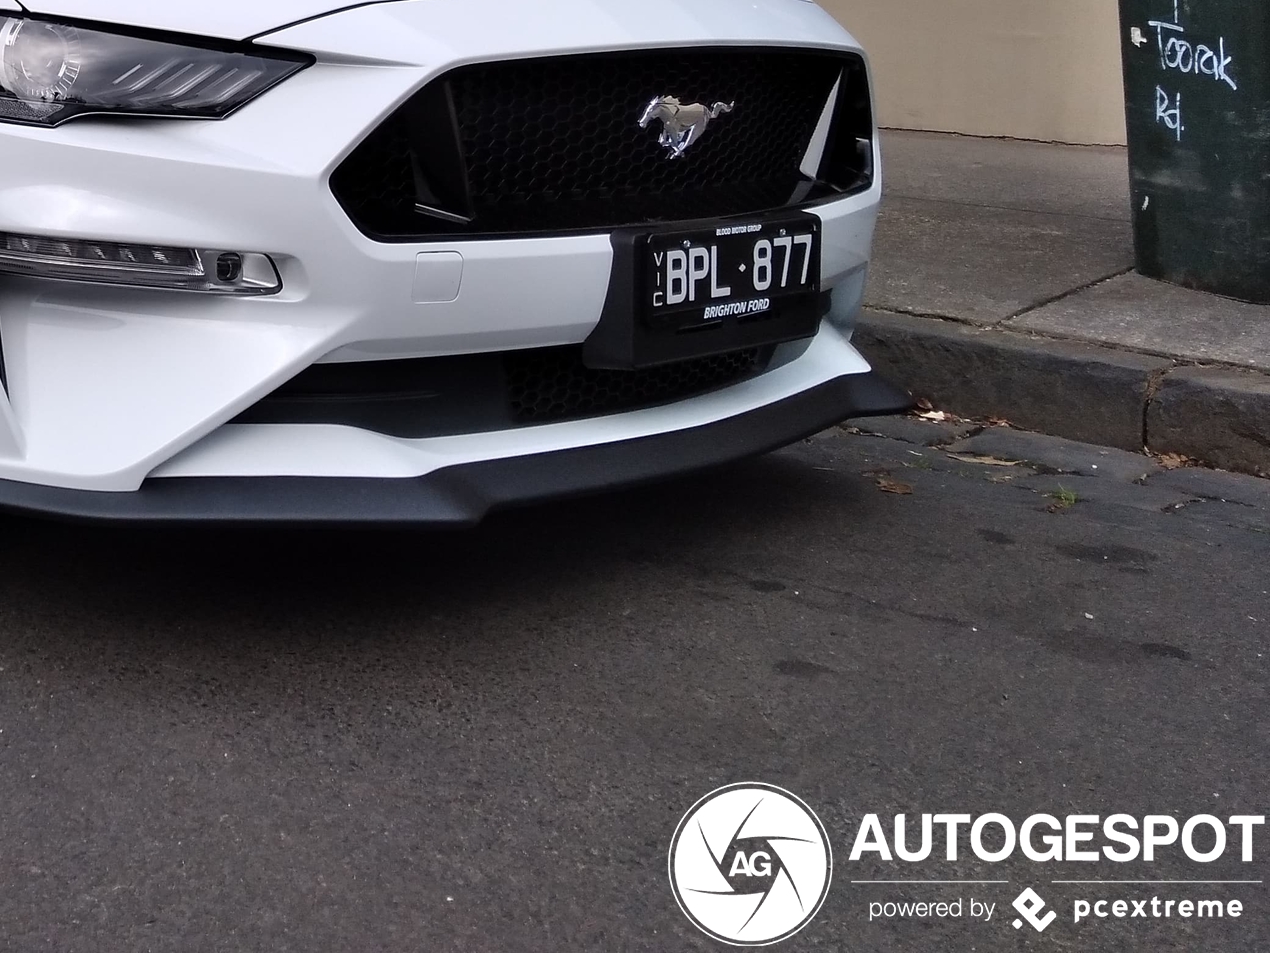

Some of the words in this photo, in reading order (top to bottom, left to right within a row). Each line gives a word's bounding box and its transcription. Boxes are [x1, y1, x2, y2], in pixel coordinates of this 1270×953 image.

[1147, 19, 1238, 91] Toorak
[652, 251, 664, 307] VIC
[666, 245, 731, 305] BPL
[753, 233, 813, 291] 877
[703, 301, 747, 320] BRIGHTON
[747, 298, 770, 315] FORD
